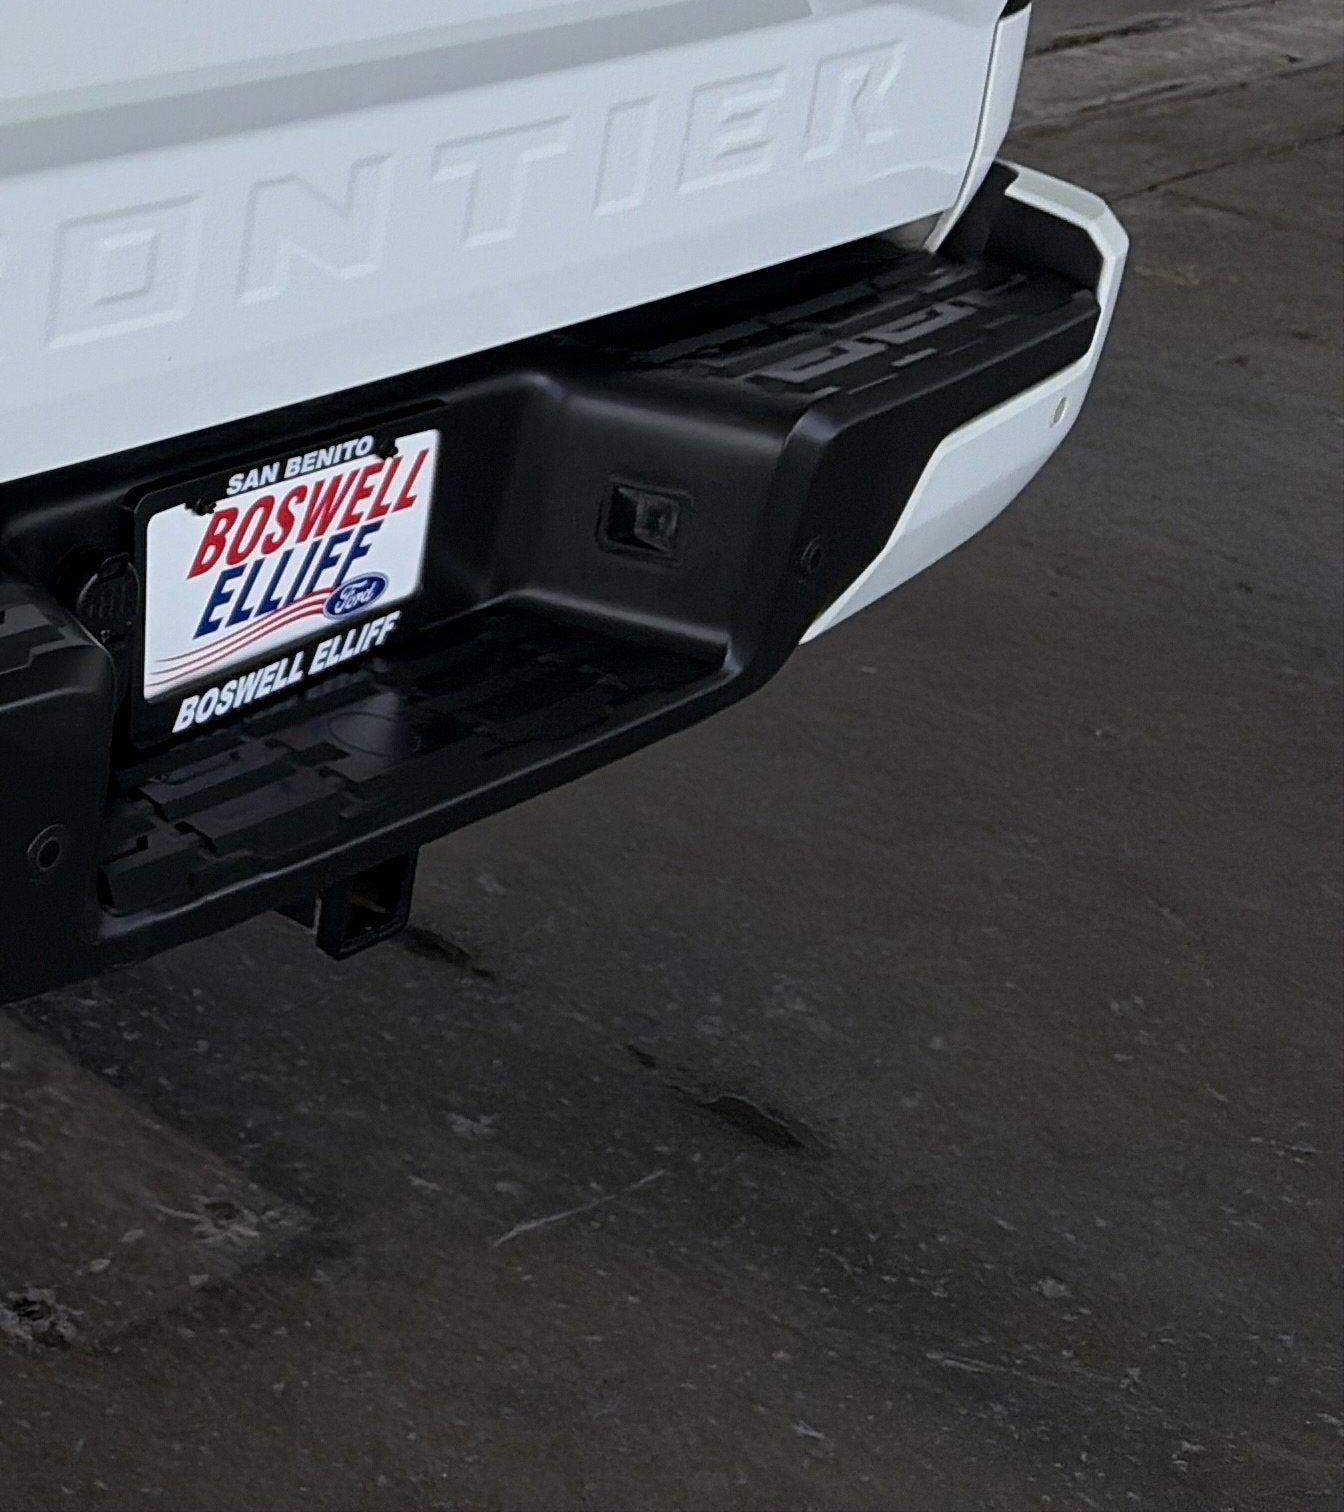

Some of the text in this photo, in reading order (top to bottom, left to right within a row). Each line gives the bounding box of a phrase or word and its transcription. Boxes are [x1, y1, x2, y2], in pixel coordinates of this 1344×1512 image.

[186, 448, 430, 580] BOSWELL
[226, 434, 374, 496] SAN BENITO
[193, 519, 385, 640] ELLIFF
[334, 580, 378, 615] Ford
[171, 610, 402, 734] BOSWELL ELLIFF
